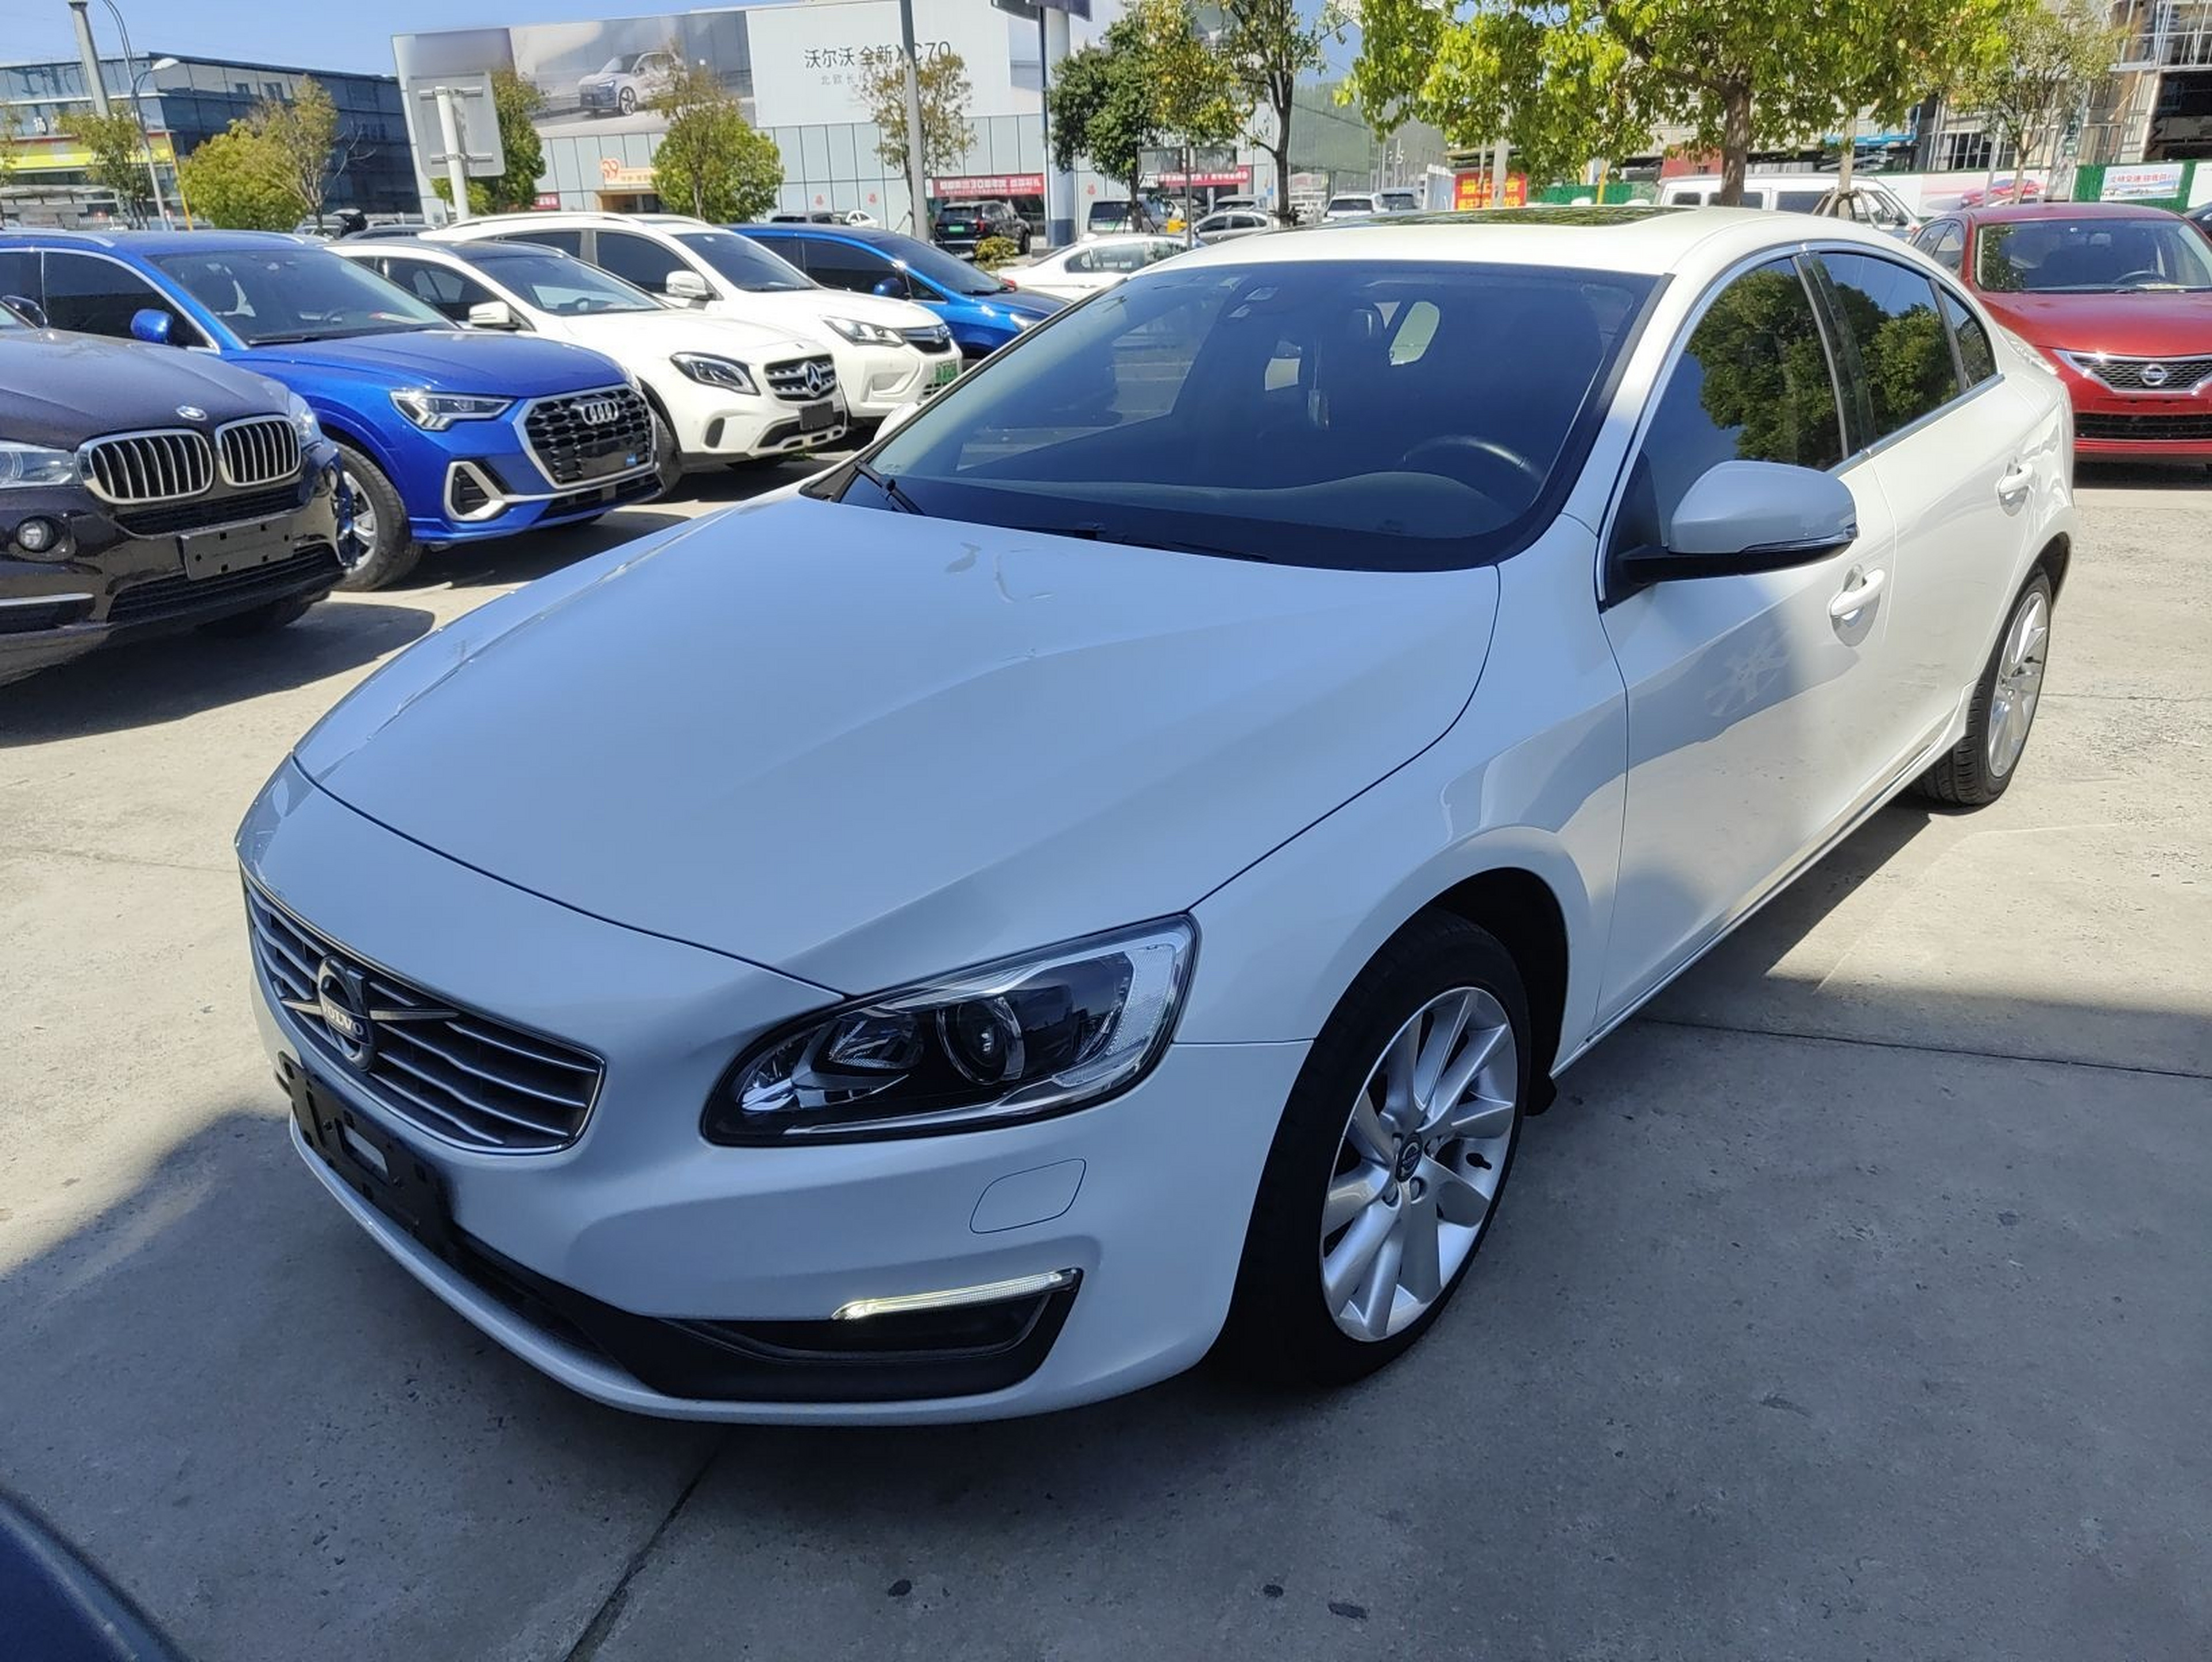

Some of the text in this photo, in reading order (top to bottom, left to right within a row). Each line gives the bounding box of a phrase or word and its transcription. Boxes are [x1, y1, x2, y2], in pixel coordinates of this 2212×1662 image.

[805, 47, 854, 68] 沃尔沃
[859, 45, 893, 66] 全新
[322, 1002, 364, 1035] VOLVO
